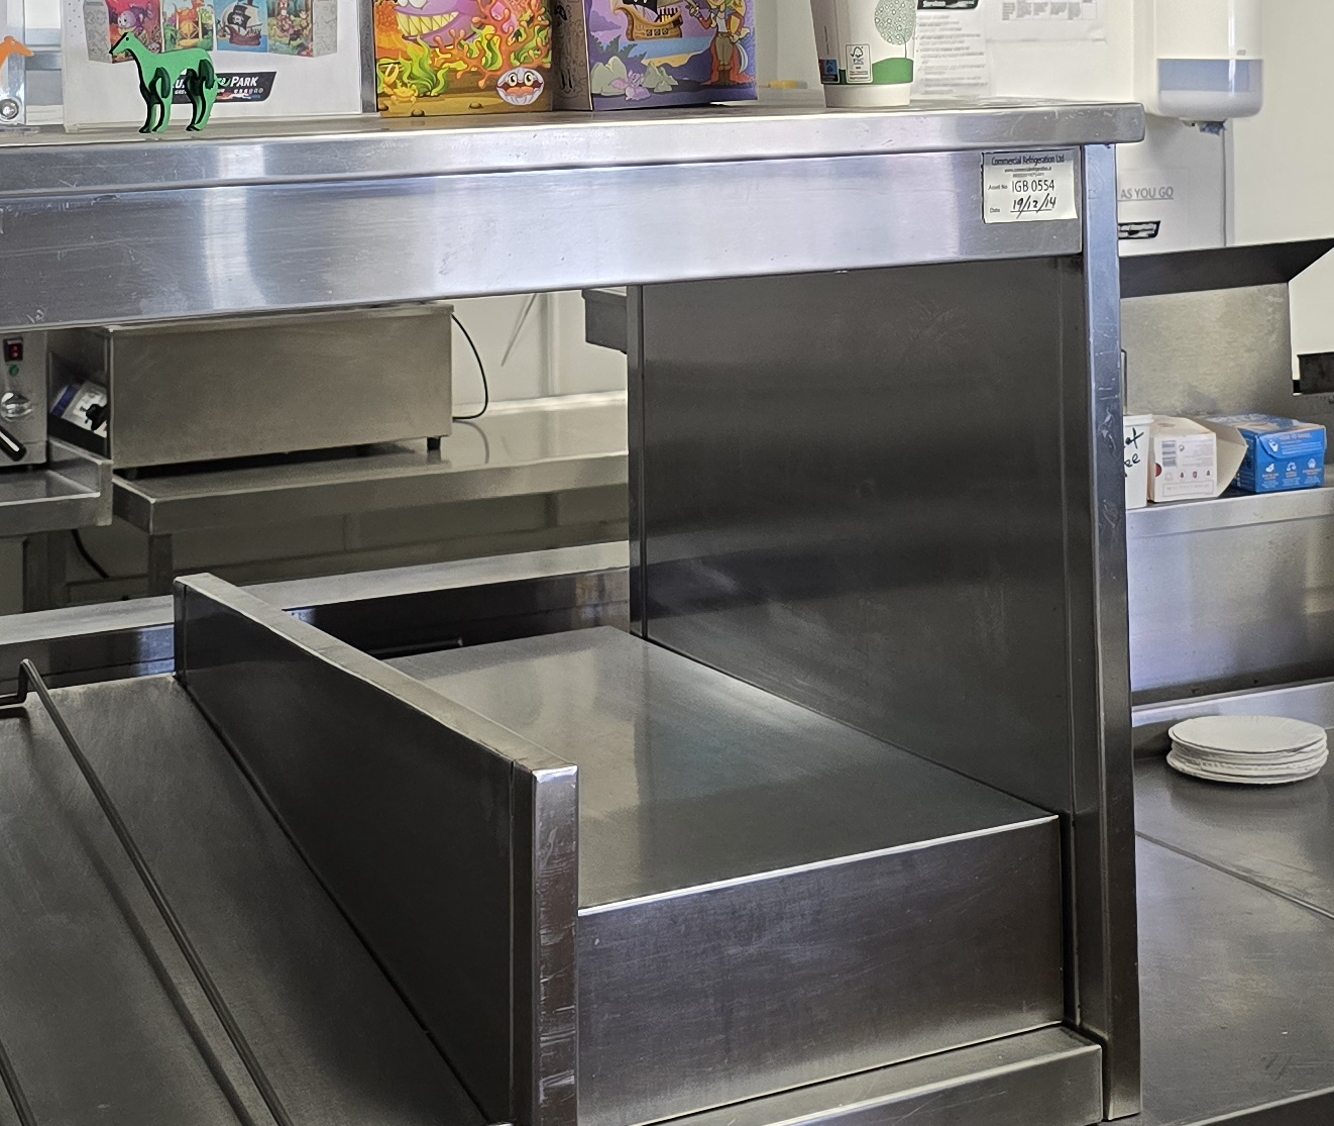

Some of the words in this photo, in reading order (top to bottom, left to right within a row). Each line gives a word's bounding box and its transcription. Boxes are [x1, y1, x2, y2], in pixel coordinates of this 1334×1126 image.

[230, 76, 259, 88] PARK
[992, 155, 1021, 166] Commercial
[1023, 155, 1055, 166] Refrigeration
[1056, 154, 1065, 163] Ltd
[1012, 180, 1028, 193] IGB
[1031, 179, 1055, 192] 0554
[1121, 189, 1132, 199] AS
[1134, 187, 1157, 198] YOU
[1159, 186, 1174, 198] GO
